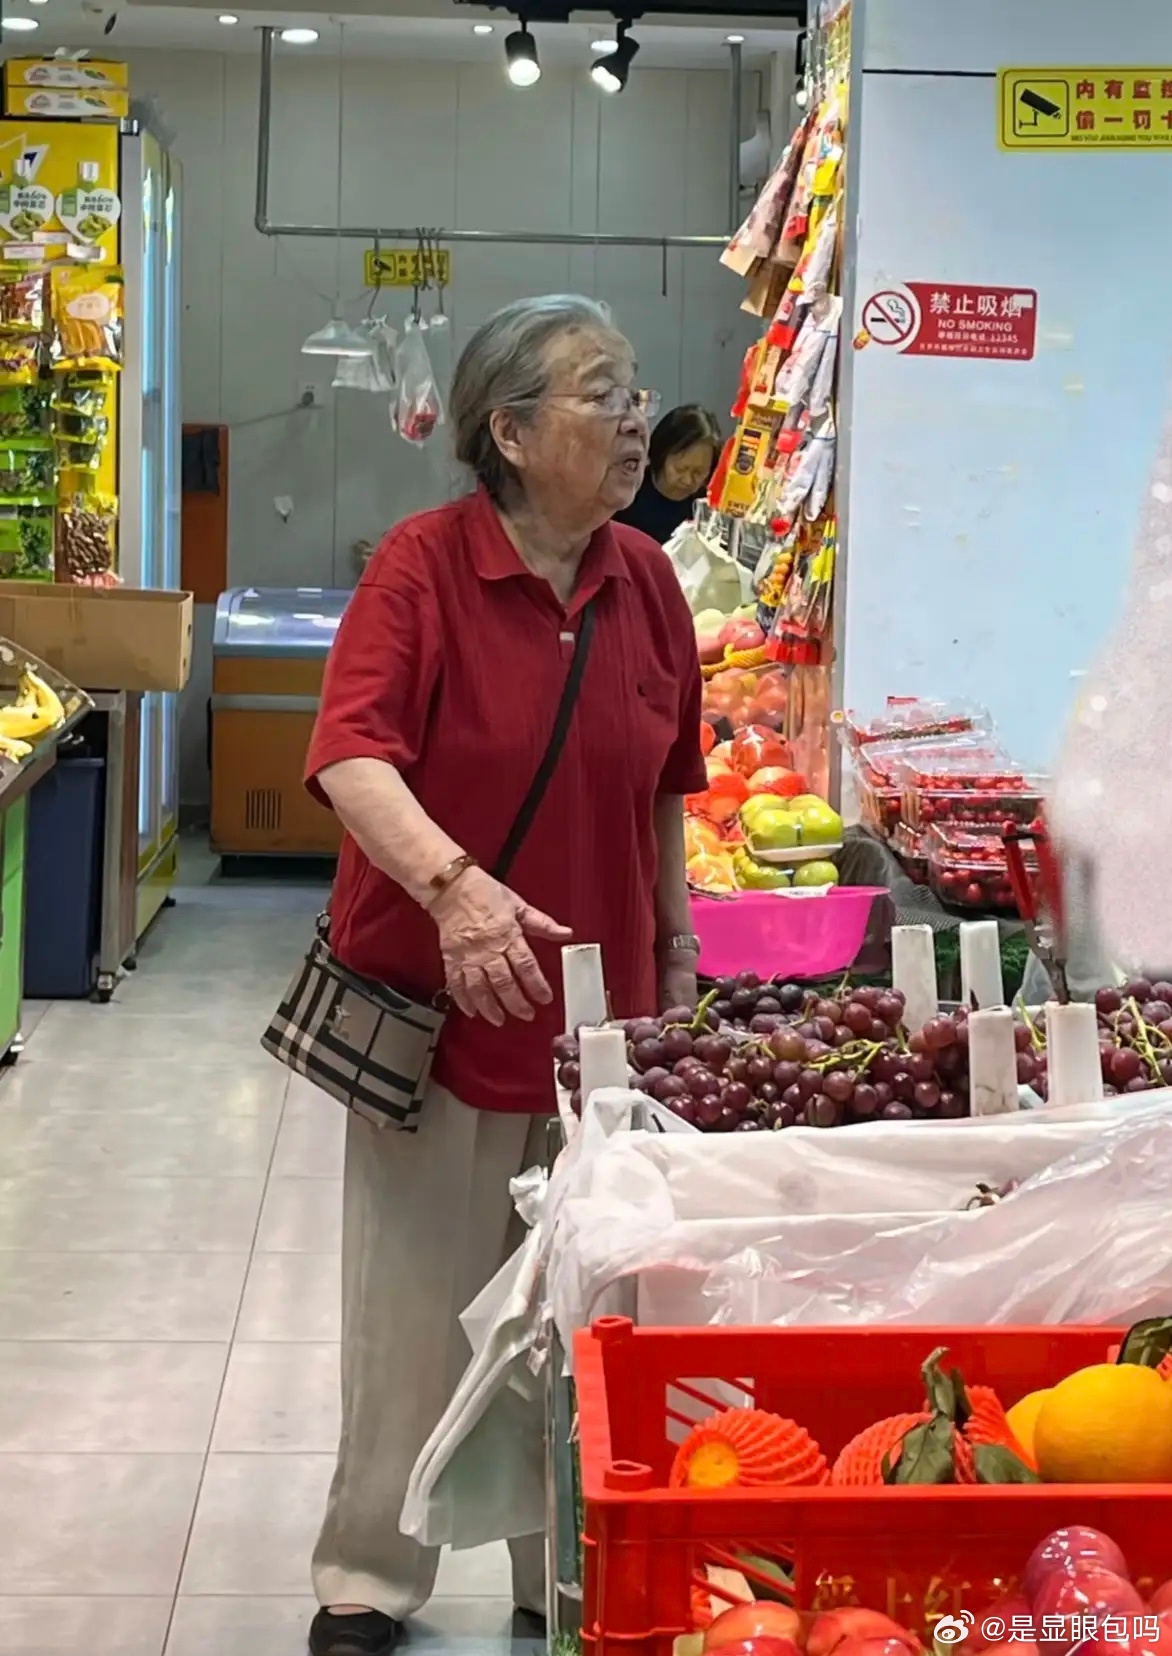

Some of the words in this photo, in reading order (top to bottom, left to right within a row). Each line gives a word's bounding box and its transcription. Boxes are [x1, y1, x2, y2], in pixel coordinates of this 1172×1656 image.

[1076, 78, 1172, 99] 内有监控
[929, 291, 1022, 319] 禁止吸烟
[938, 319, 955, 330] NO
[958, 319, 1013, 332] SMOKING
